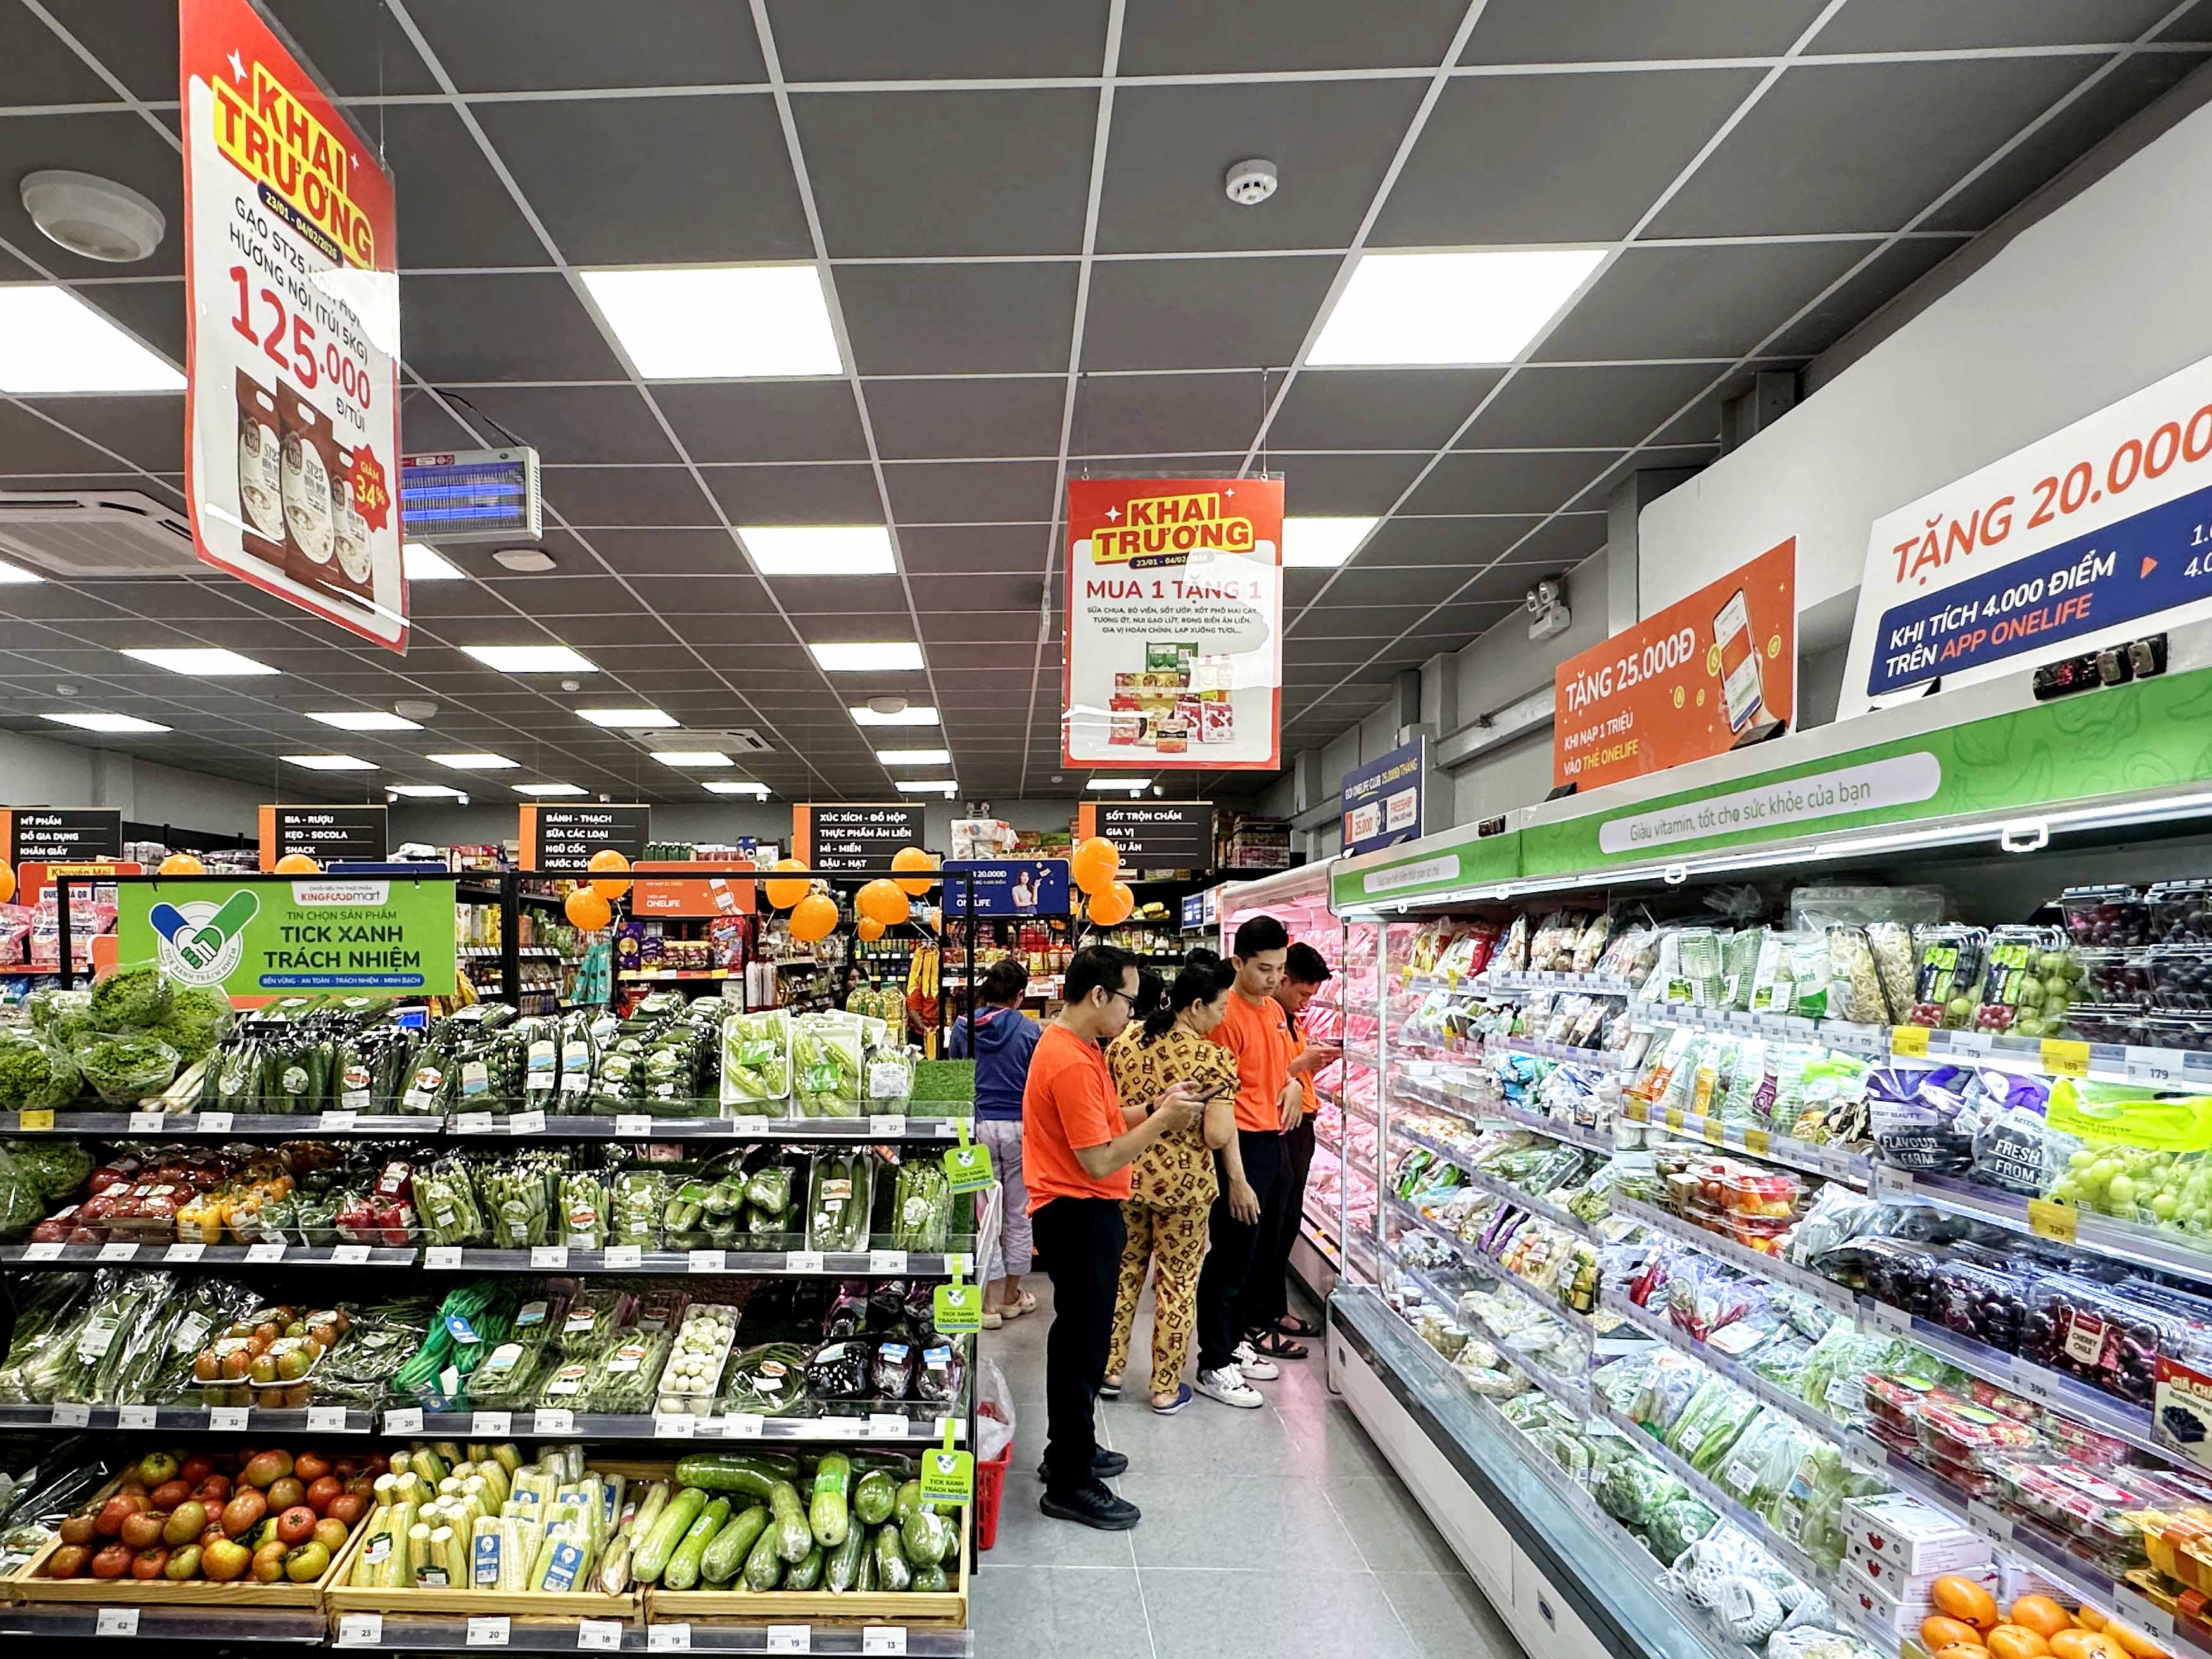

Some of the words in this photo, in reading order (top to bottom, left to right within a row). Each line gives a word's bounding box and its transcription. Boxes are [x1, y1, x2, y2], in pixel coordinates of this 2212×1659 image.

[258, 71, 347, 191] KHAI
[218, 87, 371, 261] TRƯƠNG
[265, 191, 289, 220] 23/01
[235, 195, 269, 239] GẠO
[272, 229, 305, 274] ST25
[229, 222, 284, 287] HƯƠNG
[289, 275, 312, 313] NỘI
[316, 301, 340, 338] (TÚI
[343, 332, 369, 366] 5KG)
[229, 265, 372, 410] 125.000
[336, 396, 365, 432] Đ/TÚI
[355, 474, 386, 510] 34%
[1129, 497, 1217, 527] KHAI
[1096, 520, 1250, 556] TRƯƠNG
[1892, 496, 2015, 586] TẶNG
[1087, 580, 1143, 599] MUA
[1152, 580, 1164, 599] 1
[1172, 574, 1240, 605] TẶNG
[1249, 581, 1262, 599] 1
[1889, 619, 1924, 650] KHI
[1930, 604, 1978, 636] TÍCH
[1981, 579, 2044, 619] 4.000
[2047, 550, 2117, 597] ĐIỂM
[1887, 640, 1938, 678] TRÊN
[1940, 628, 1987, 662] APP
[1990, 593, 2093, 645] ONELIFE
[1565, 671, 1612, 716] TẶNG
[1616, 627, 1695, 691] 25.000Đ
[1564, 733, 1579, 751] KHI
[1580, 728, 1598, 747] NẠP
[1600, 725, 1606, 740] 1
[1607, 710, 1634, 737] TRIỆU
[1564, 757, 1581, 776] VÀO
[1583, 748, 1601, 771] THẺ
[1602, 738, 1639, 765] ONELIFE
[545, 812, 572, 824] BÁNH
[580, 814, 612, 824] THẠCH
[819, 811, 839, 822] XÚC
[840, 811, 863, 822] XÍCH
[886, 811, 907, 824] HỘP
[1105, 809, 1125, 821] SỐT
[1125, 810, 1153, 822] TRỘN
[1153, 809, 1182, 821] CHẤM
[1630, 823, 1652, 842] Giàu
[1654, 814, 1696, 836] vitamin,
[1697, 807, 1716, 829] tốt
[1717, 807, 1740, 825] cho
[1743, 797, 1766, 820] sức
[1769, 789, 1803, 815] khỏe
[1807, 783, 1834, 808] của
[1839, 781, 1871, 806] bạn
[20, 816, 34, 826] MỸ
[284, 816, 301, 824] BIA
[308, 814, 334, 826] RƯỢU
[35, 833, 52, 841] GIA
[53, 832, 79, 842] DỤNG
[284, 831, 304, 841] KẸO
[311, 831, 348, 839] SOCOLA
[545, 828, 565, 839] SỮA
[567, 828, 585, 838] CÁC
[587, 830, 609, 840] LOẠI
[819, 828, 845, 839] THỰC
[876, 827, 890, 837] ĂN
[1105, 828, 1123, 836] GIA
[1124, 828, 1134, 838] VỊ
[20, 846, 46, 855] KHĂN
[284, 846, 316, 854] SNACK
[545, 843, 566, 854] NGŨ
[567, 842, 587, 854] CỐC
[819, 842, 831, 852] MÌ
[1127, 842, 1142, 851] ĂN
[545, 857, 572, 867] NƯỚC
[819, 857, 840, 869] ĐẬU
[847, 859, 868, 869] HẠT
[646, 899, 680, 907] ONELIFE
[287, 911, 303, 921] TIN
[307, 911, 338, 923] CHỌN
[280, 926, 331, 942] TICK
[338, 926, 403, 942] XANH
[263, 946, 341, 968] TRÁCH
[350, 945, 420, 972] NHIỆM
[1967, 1049, 1980, 1059] 179
[2064, 1061, 2077, 1071] 159
[2151, 1068, 2169, 1079] 179
[1883, 1135, 1938, 1148] FLAVOUR
[1995, 1139, 2041, 1164] FRESH
[1900, 1152, 1935, 1165] FARM
[1995, 1159, 2035, 1183] FROM
[2049, 1225, 2065, 1236] 329
[2030, 1383, 2047, 1397] 399
[1986, 1527, 2002, 1542] 319
[2144, 1622, 2159, 1638] 75
